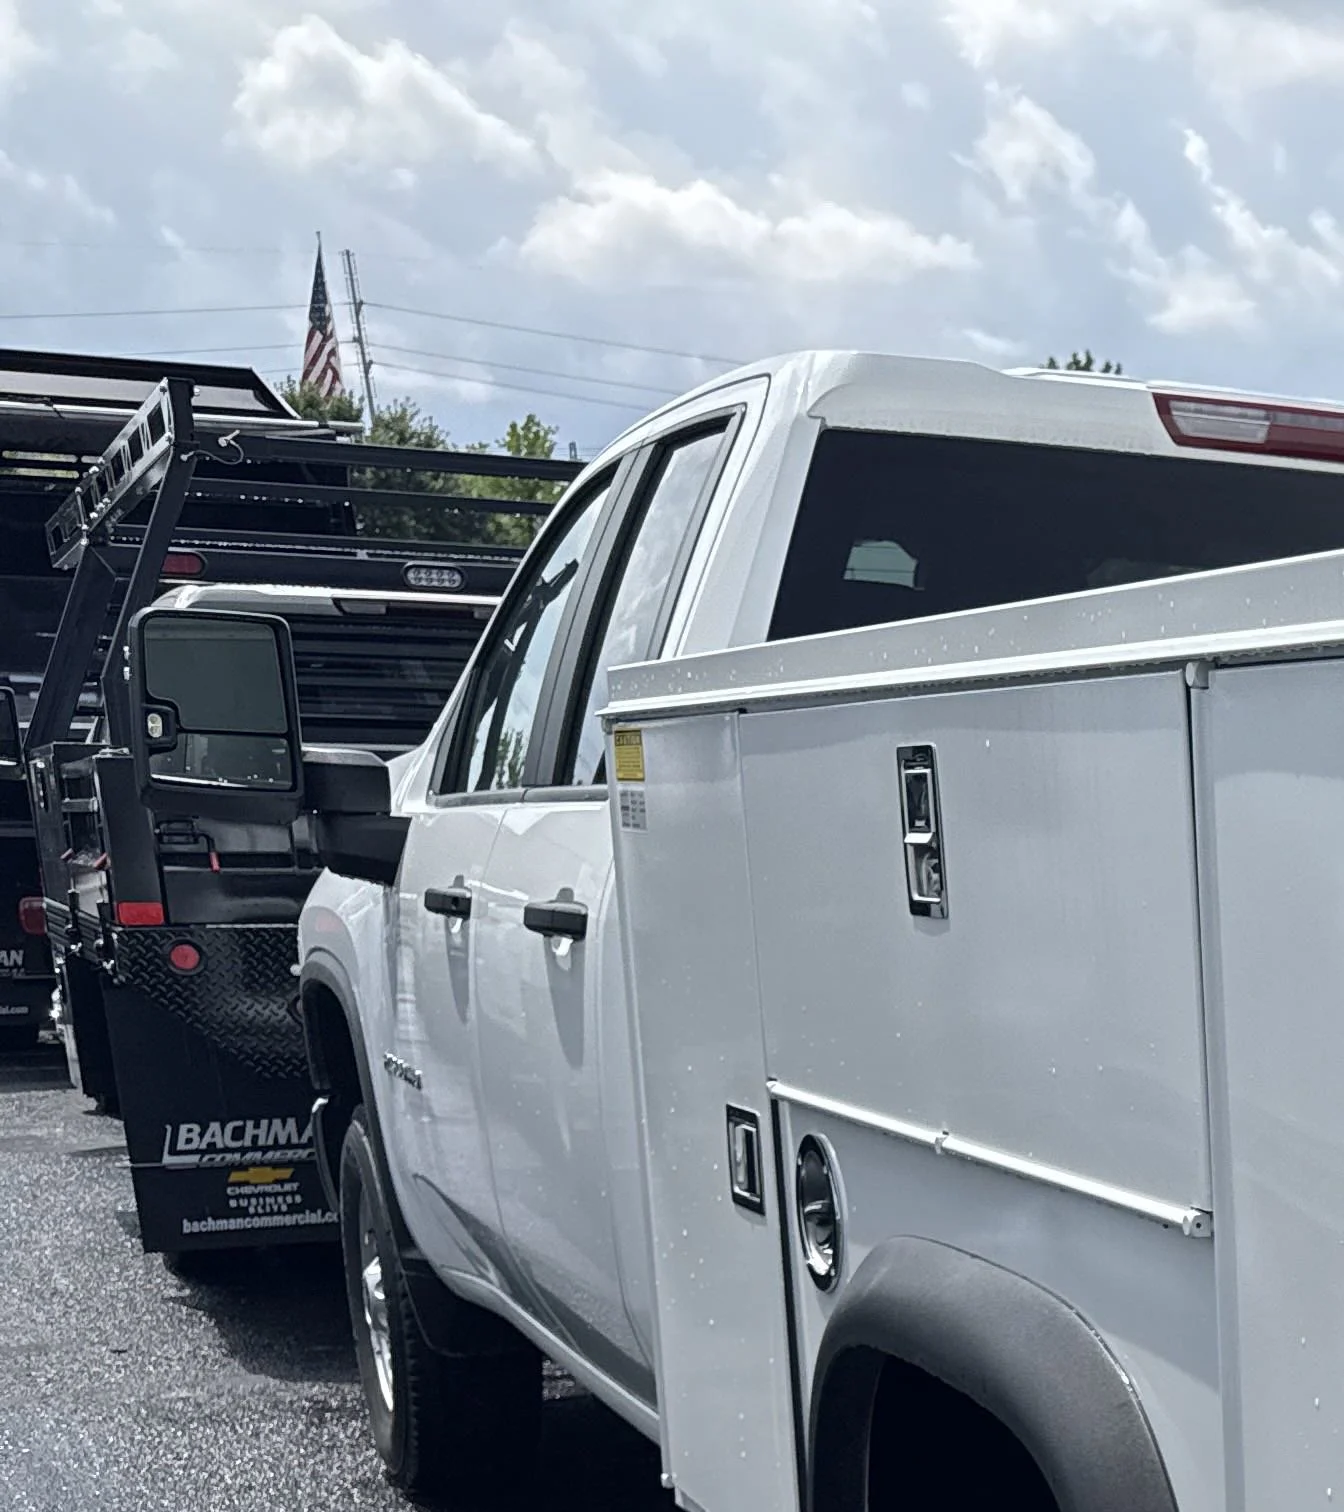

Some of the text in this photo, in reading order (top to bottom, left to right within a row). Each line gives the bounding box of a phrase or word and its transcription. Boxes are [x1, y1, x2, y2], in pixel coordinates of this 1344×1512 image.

[226, 1182, 300, 1195] CHEVROLET
[229, 1195, 301, 1207] BUSINESS
[248, 1204, 287, 1214] ELITE
